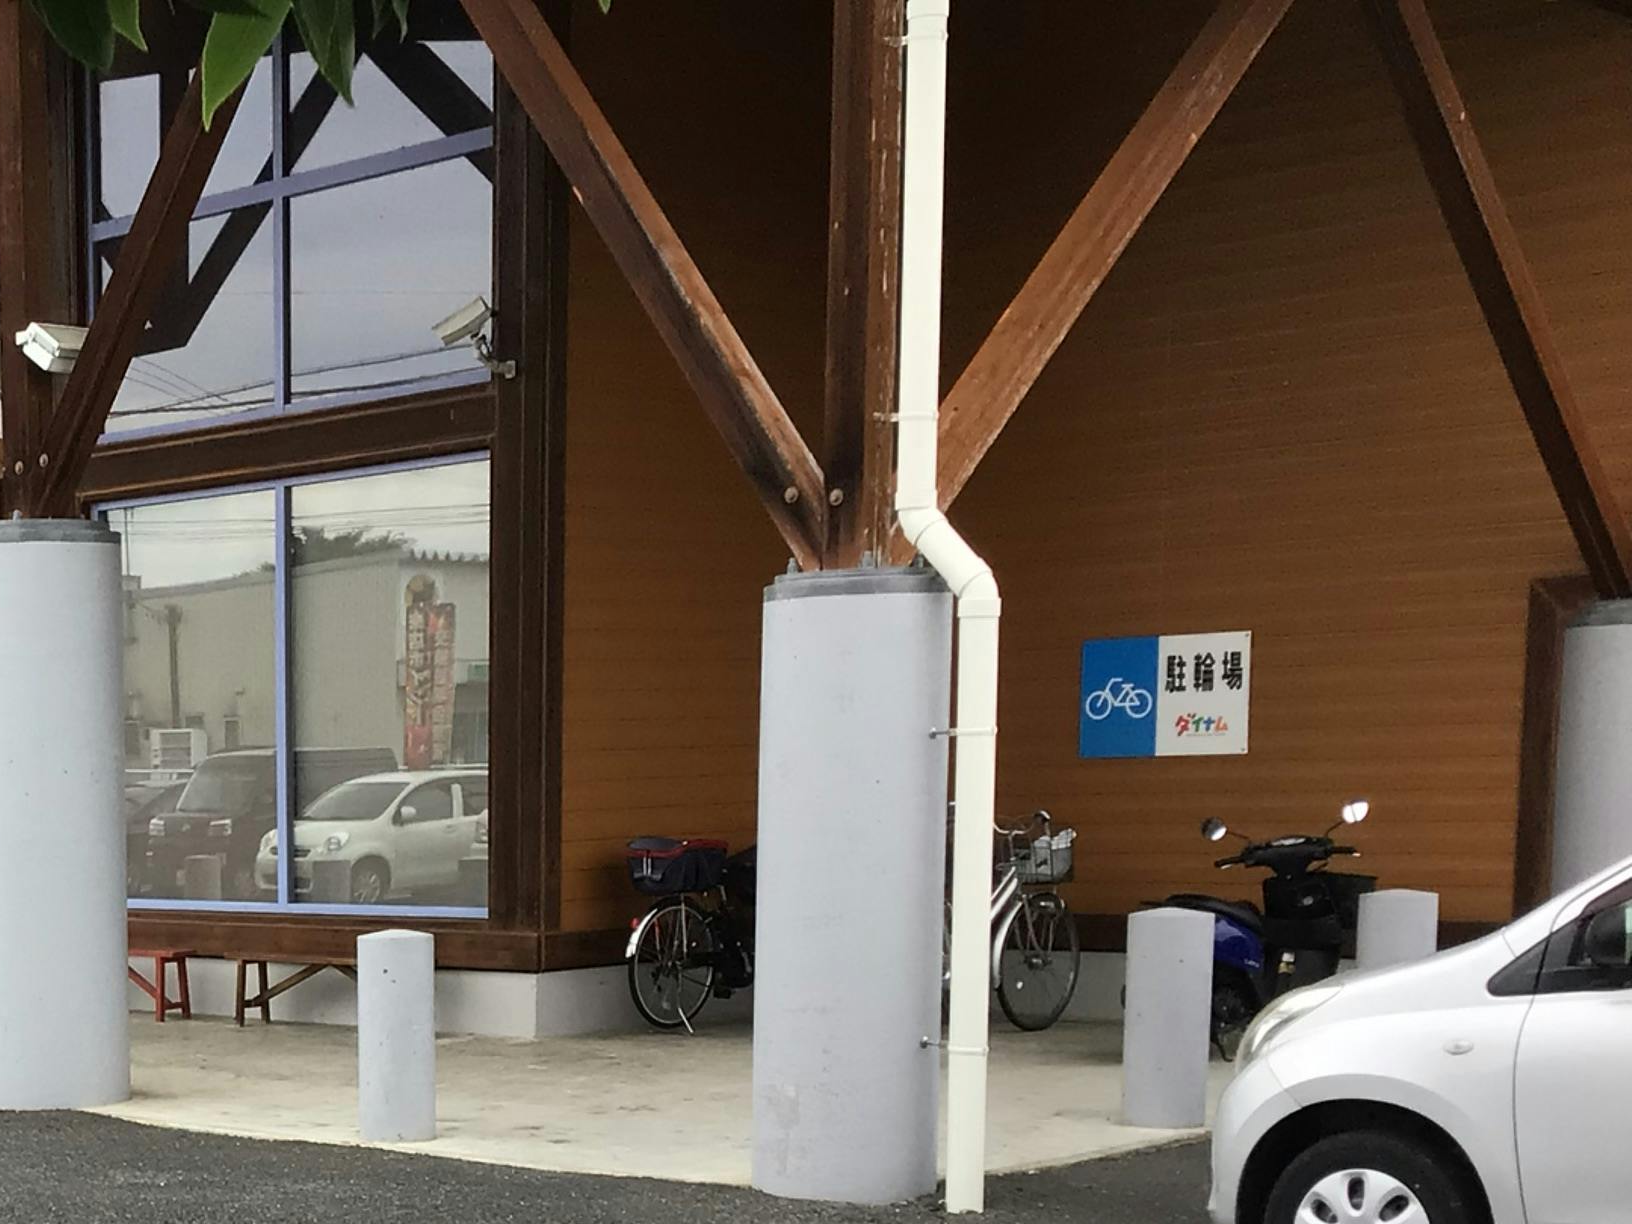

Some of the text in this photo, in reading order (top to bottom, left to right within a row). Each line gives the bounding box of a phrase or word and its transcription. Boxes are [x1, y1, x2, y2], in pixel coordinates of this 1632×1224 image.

[1165, 651, 1243, 693] 駐輪場
[1175, 713, 1228, 737] ダイナム
